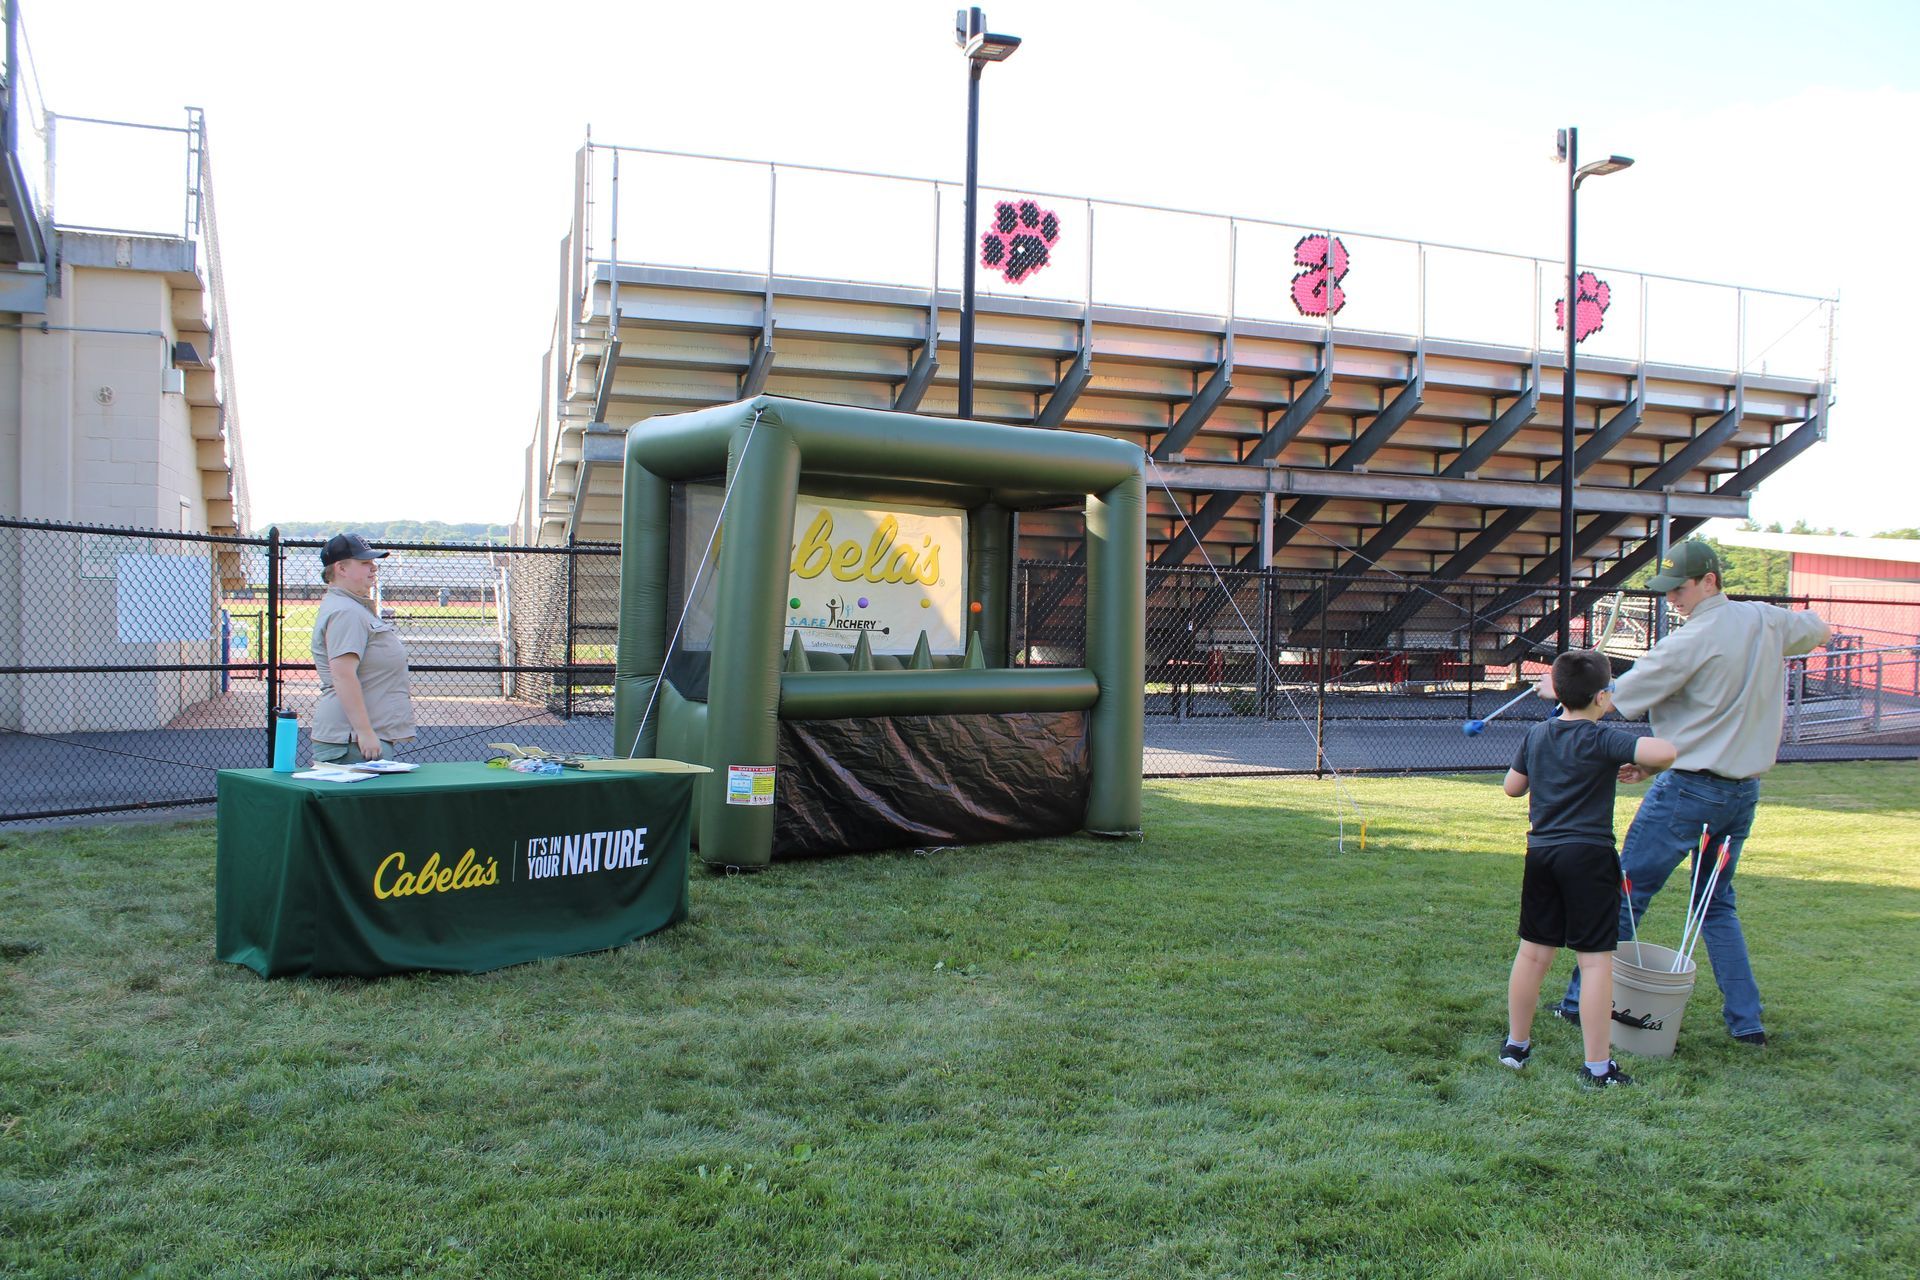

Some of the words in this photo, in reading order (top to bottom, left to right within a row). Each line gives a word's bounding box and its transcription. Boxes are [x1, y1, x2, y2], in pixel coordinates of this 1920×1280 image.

[528, 839, 548, 856] IT'S
[550, 836, 562, 854] IN
[528, 855, 560, 880] YOUR
[562, 828, 649, 876] NATURE.
[373, 848, 498, 900] Cabela's
